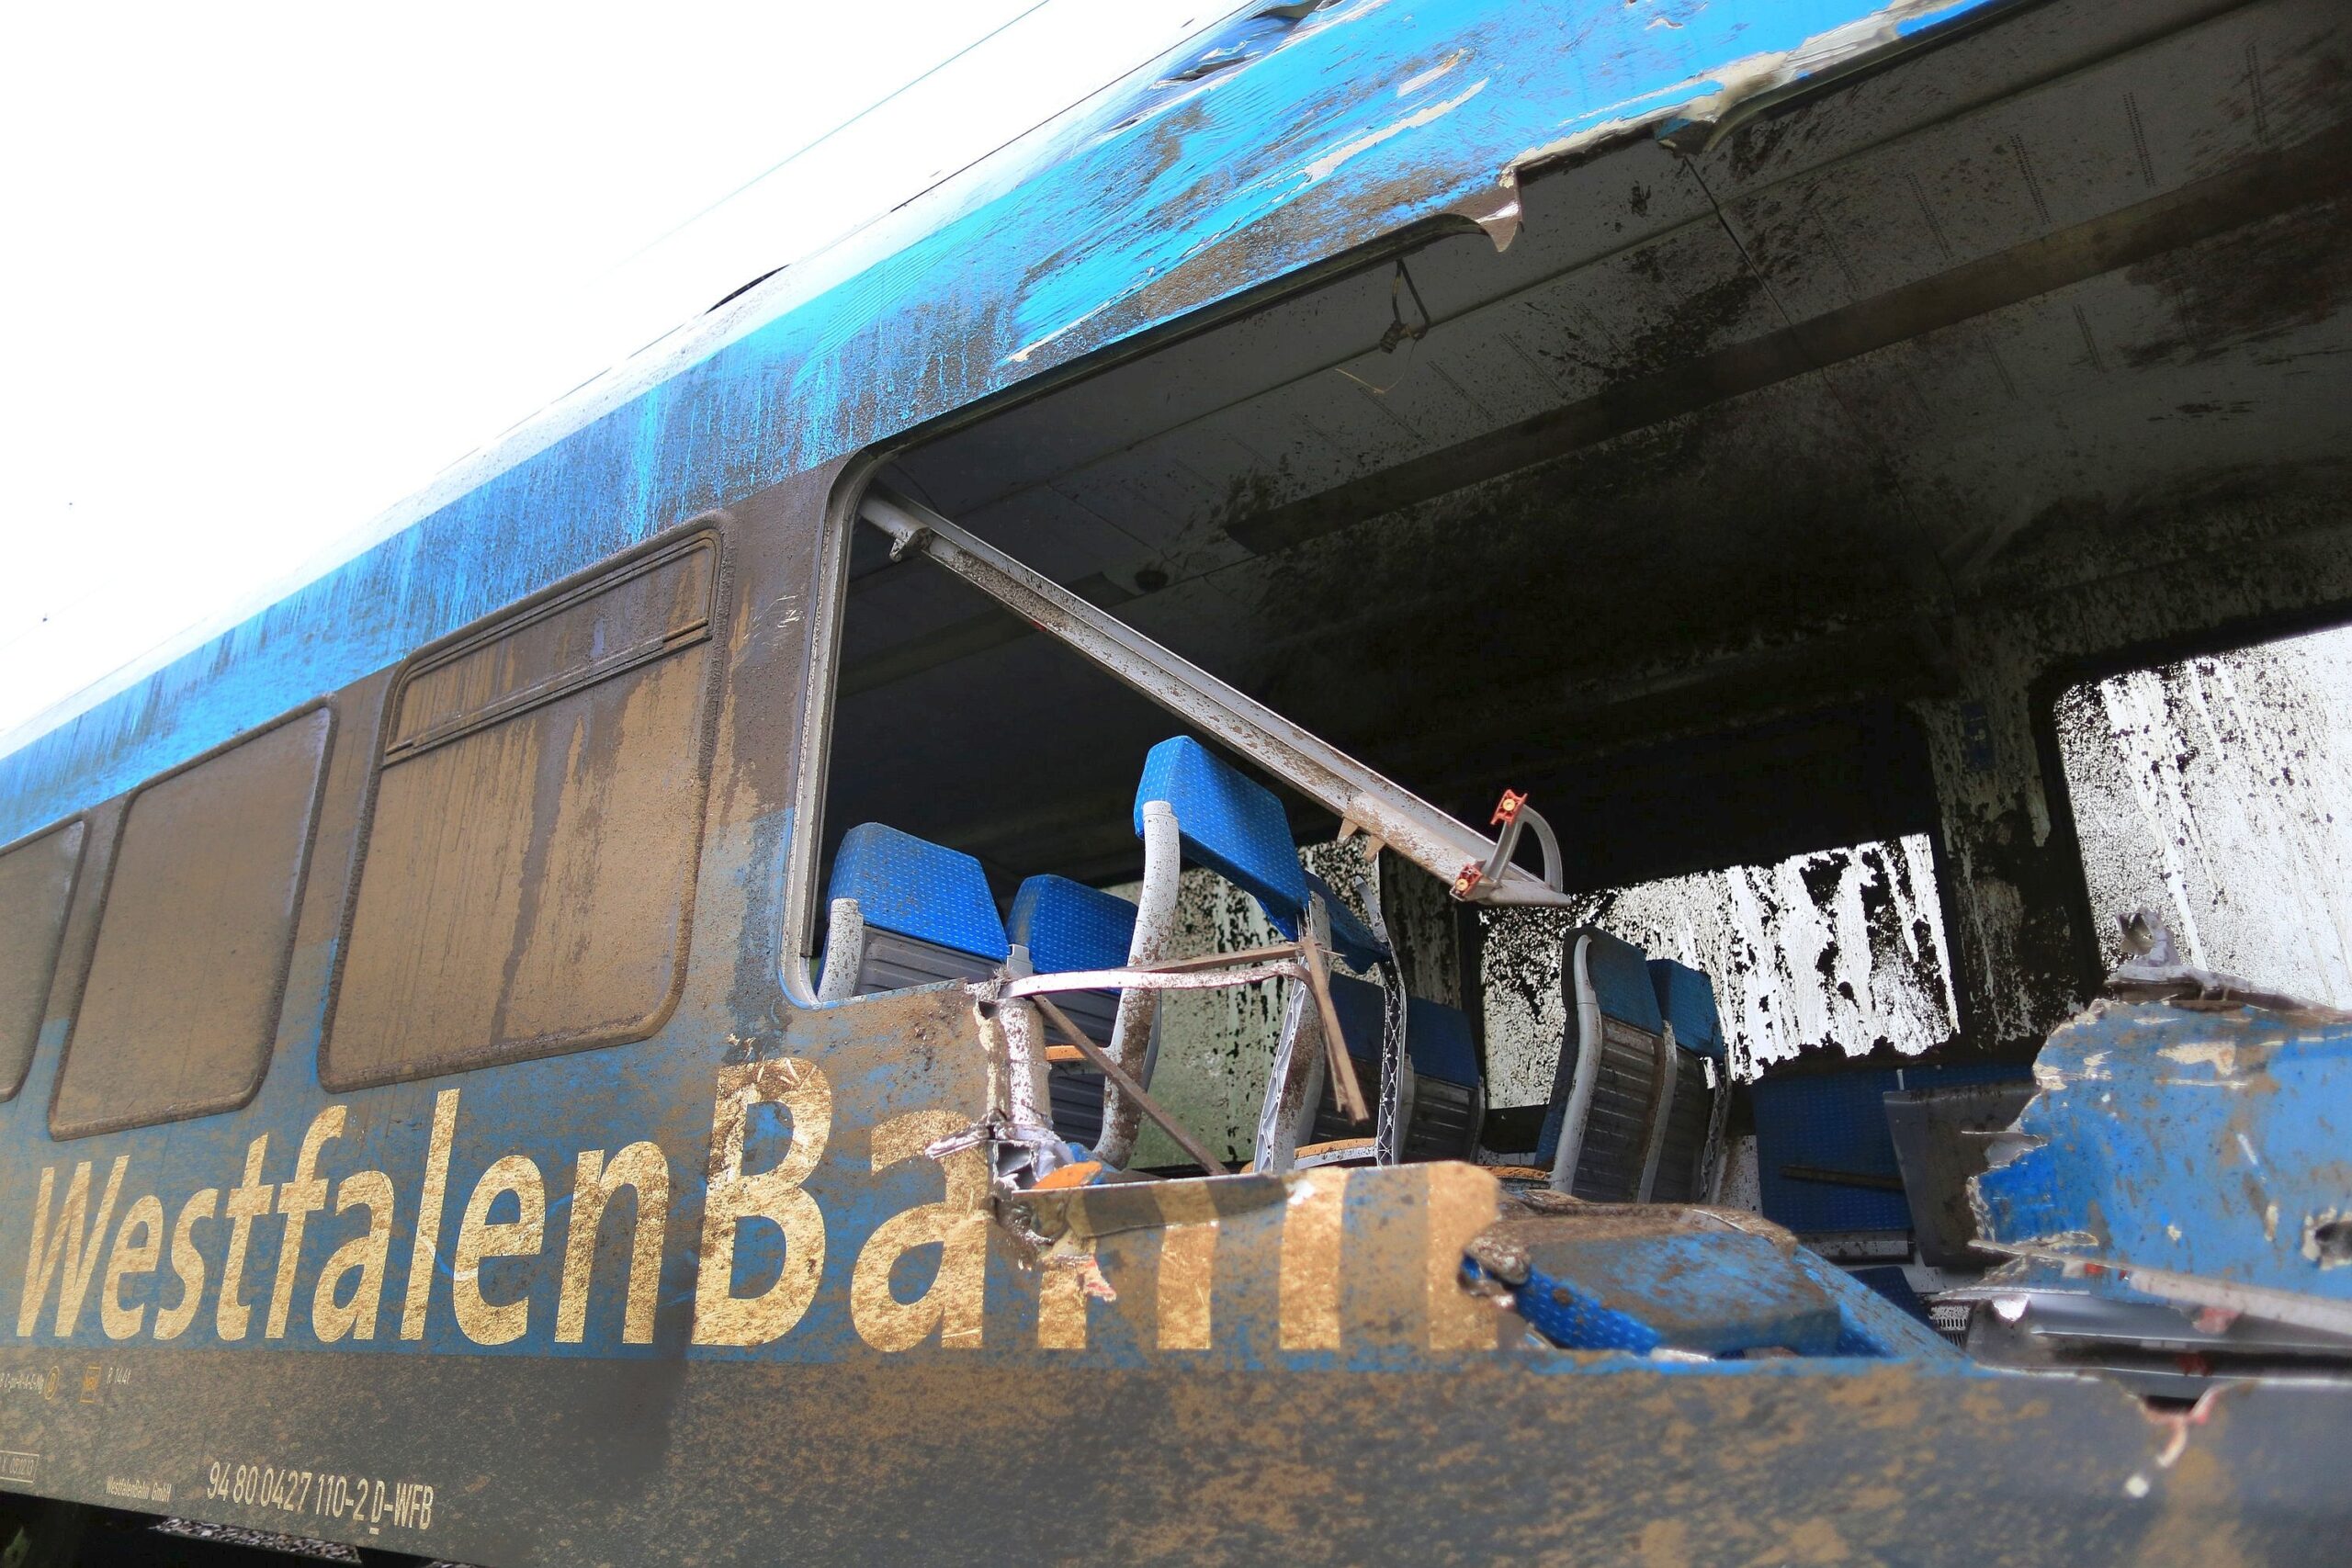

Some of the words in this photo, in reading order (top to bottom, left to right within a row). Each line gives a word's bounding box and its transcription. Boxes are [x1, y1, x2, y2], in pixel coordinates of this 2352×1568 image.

[151, 1482, 173, 1503] GmbH
[207, 1461, 231, 1502] 94
[232, 1465, 259, 1506] 80
[260, 1468, 313, 1514] 0427
[315, 1473, 369, 1521] 110-2
[369, 1480, 435, 1531] D-WFB
